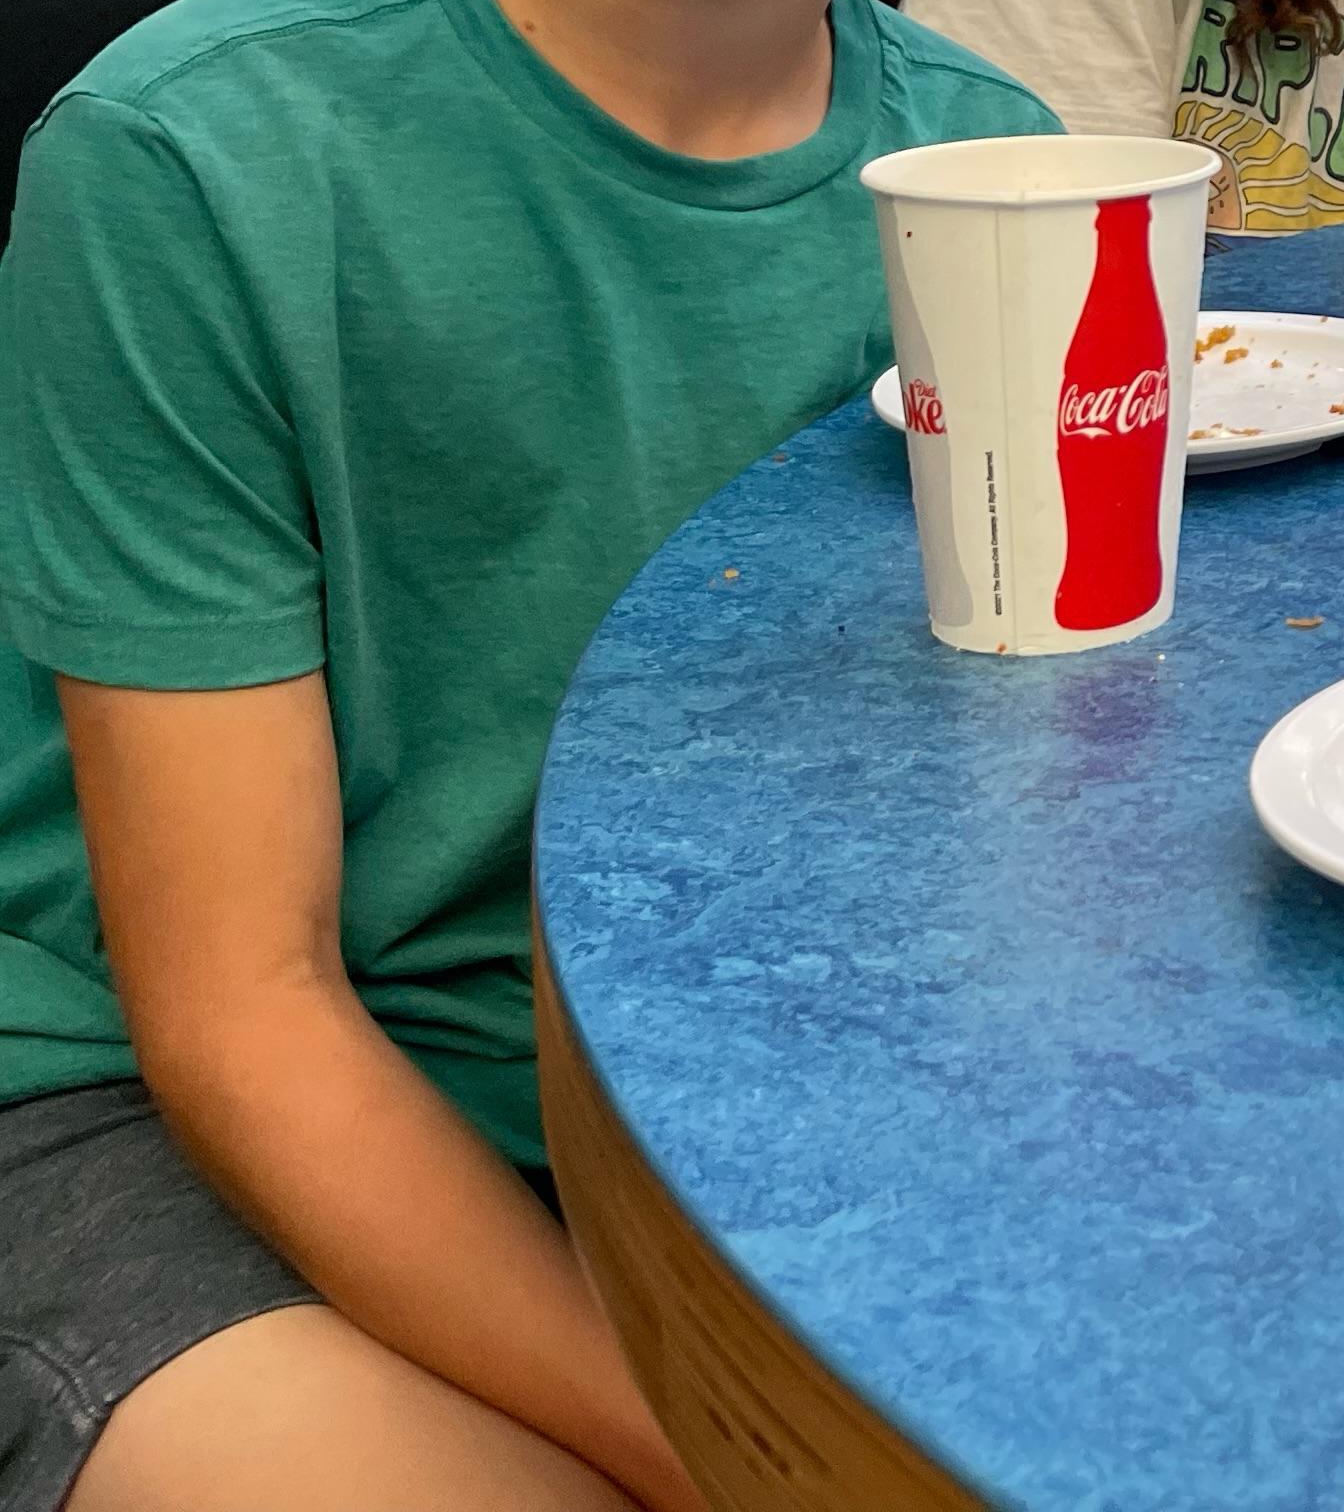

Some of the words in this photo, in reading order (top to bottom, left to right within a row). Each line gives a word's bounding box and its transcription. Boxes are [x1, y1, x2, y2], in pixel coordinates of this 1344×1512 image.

[903, 383, 947, 435] ke
[1060, 365, 1168, 439] Coca-Cola
[993, 580, 1001, 592] The
